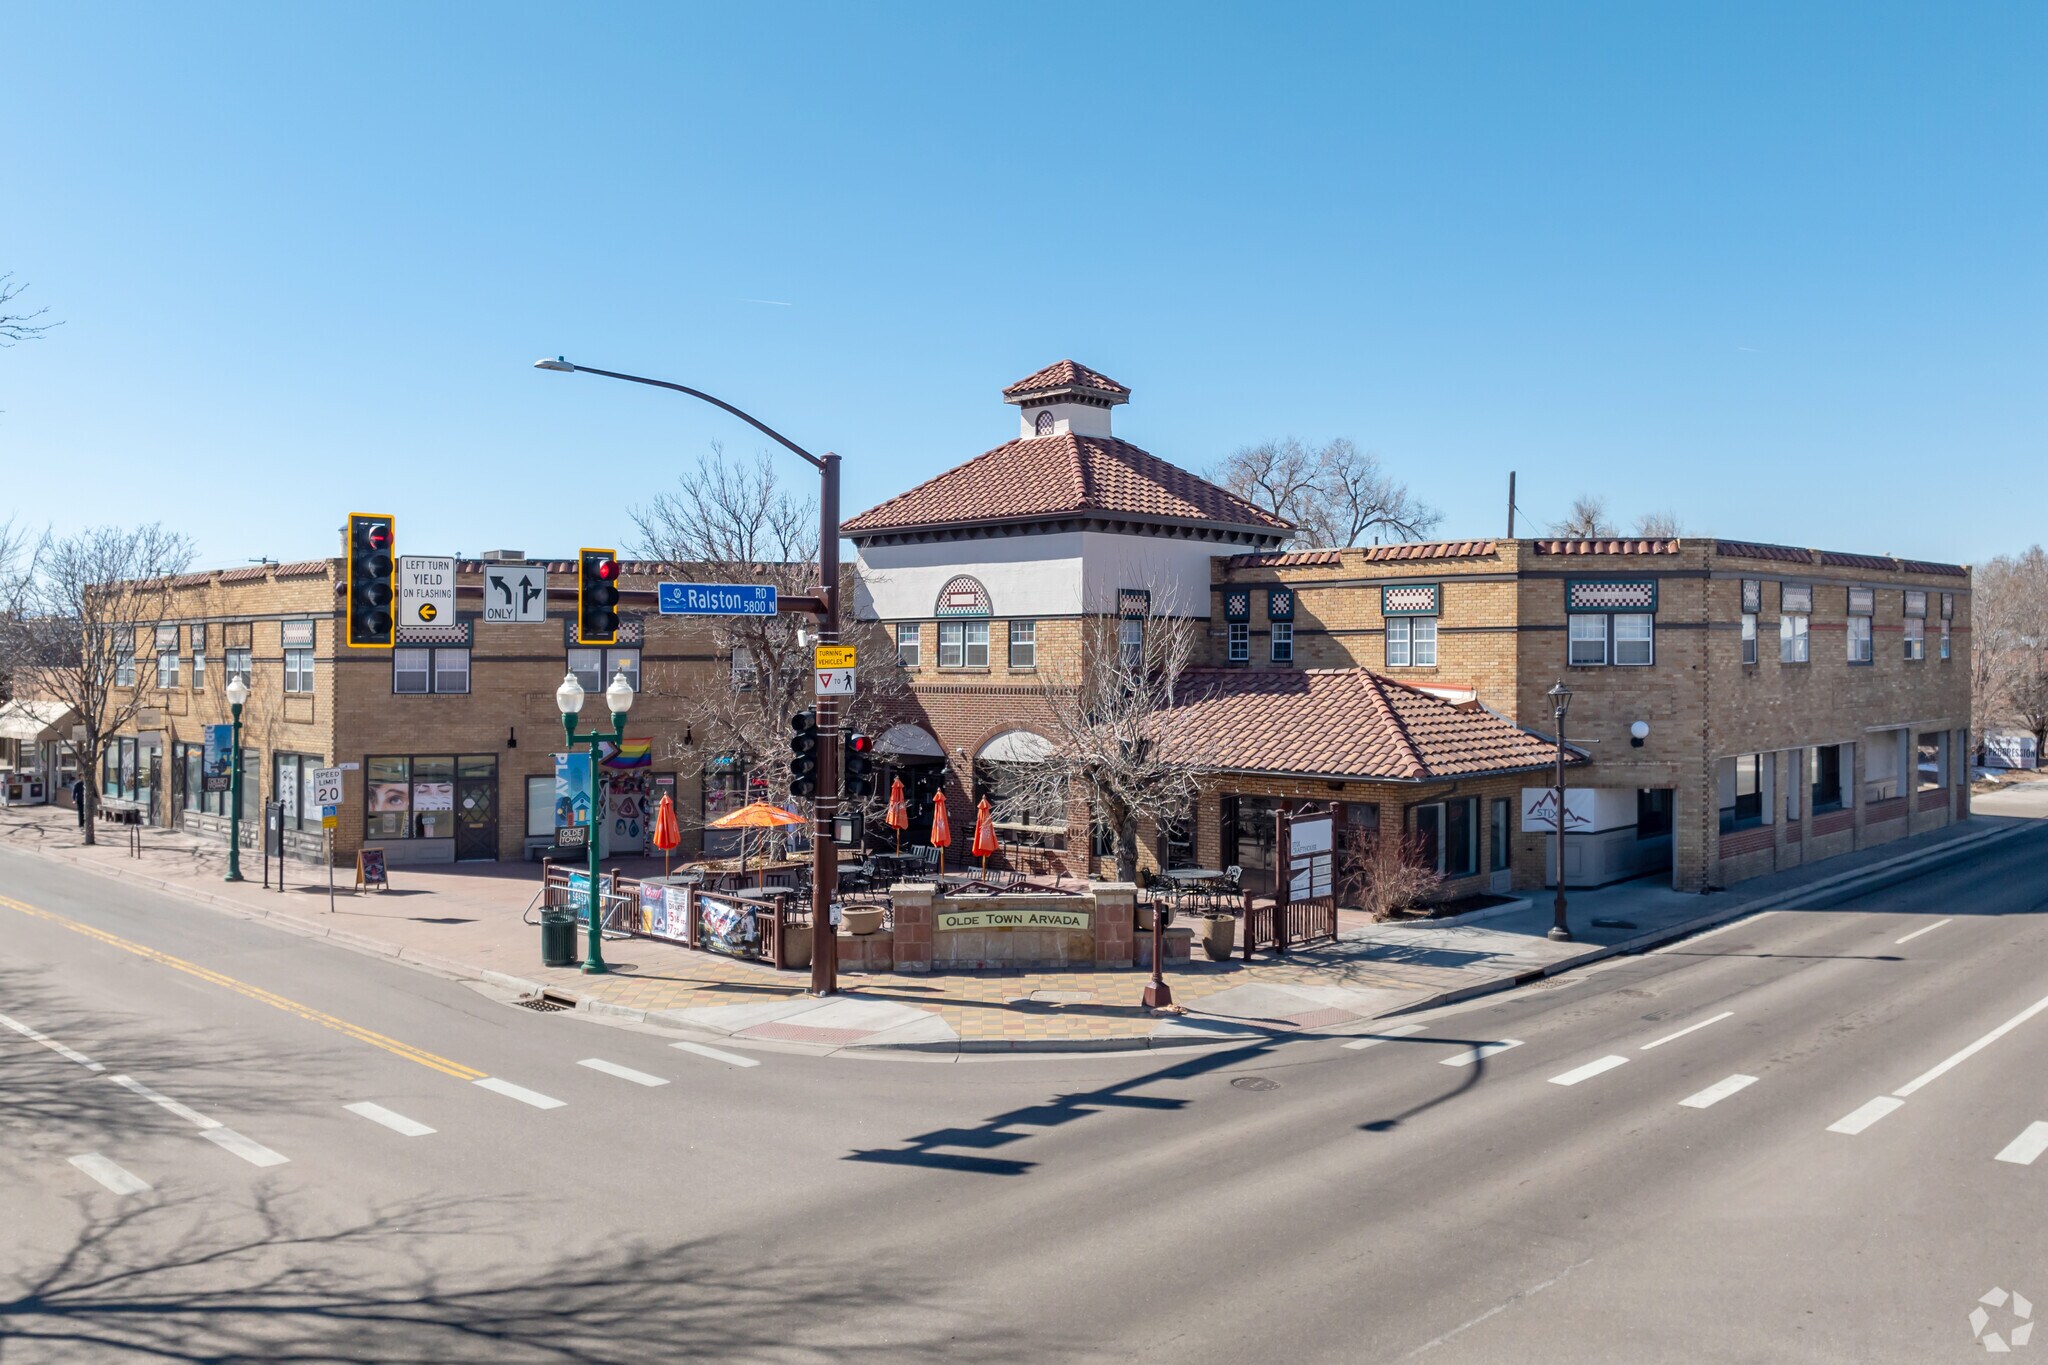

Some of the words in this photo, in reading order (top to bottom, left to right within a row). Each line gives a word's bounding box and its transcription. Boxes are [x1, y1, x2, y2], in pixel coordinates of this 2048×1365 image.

[405, 561, 425, 570] LEFT
[427, 561, 449, 571] TURN
[413, 574, 442, 585] YIELD
[403, 589, 414, 598] ON
[416, 589, 452, 599] FLASHING
[688, 589, 741, 610] Ralston
[755, 588, 767, 599] RD
[743, 601, 766, 613] 5800
[768, 601, 775, 612] N
[487, 608, 514, 619] ONLY
[818, 658, 843, 666] VEHICLES
[315, 771, 340, 779] SPEED
[556, 753, 569, 797] PLAY
[318, 779, 337, 787] LIMIT
[318, 787, 340, 802] 20
[561, 836, 583, 844] TOWN
[946, 916, 980, 926] OLDE
[986, 914, 1023, 924] TOWN
[1028, 914, 1081, 926] ARVADA
